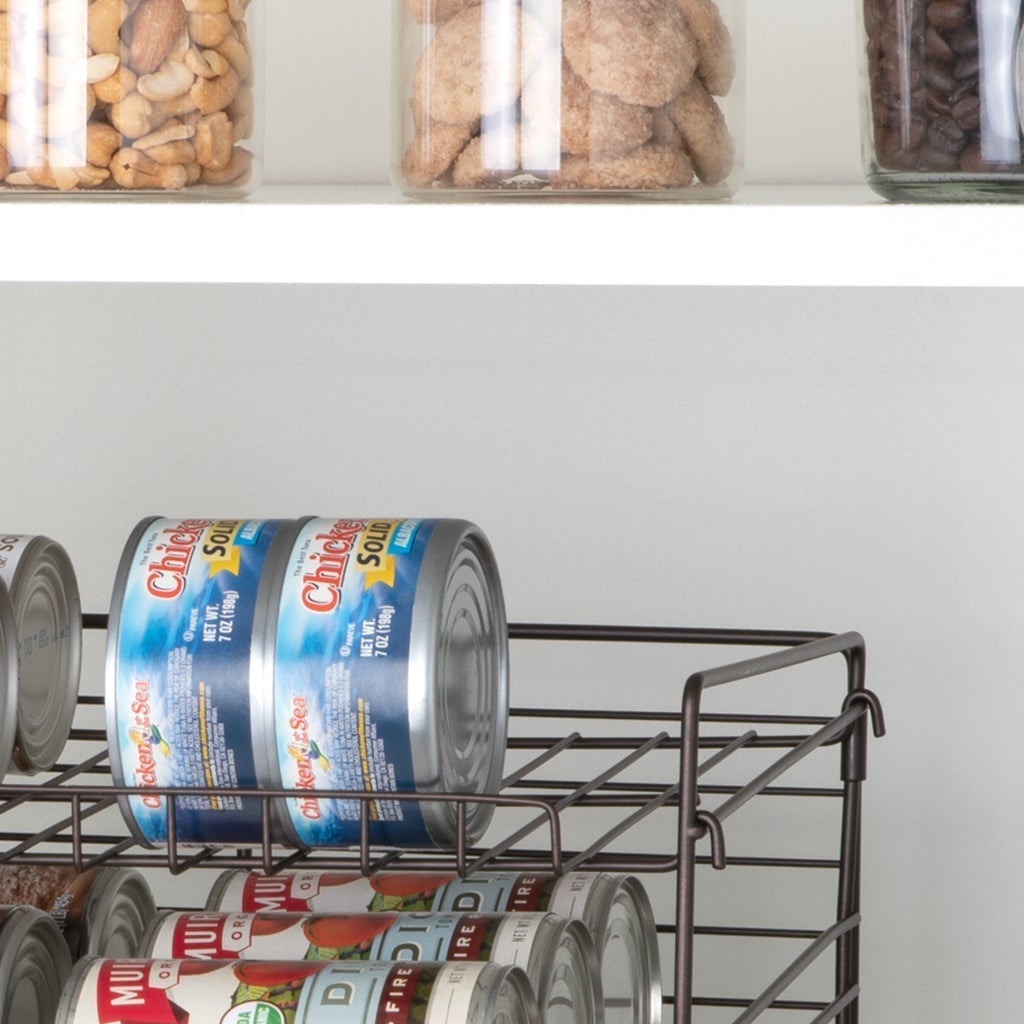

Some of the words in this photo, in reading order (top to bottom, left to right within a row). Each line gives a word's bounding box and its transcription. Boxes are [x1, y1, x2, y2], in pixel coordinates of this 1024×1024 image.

[204, 603, 220, 621] WT.
[219, 590, 240, 618] (198g)
[219, 619, 233, 634] OZ
[361, 618, 376, 637] WT.
[376, 605, 396, 634] (198g)
[203, 621, 216, 642] NET
[360, 637, 373, 657] NET
[375, 634, 389, 650] OZ
[131, 680, 150, 716] Sea
[289, 694, 308, 731] Sea
[512, 929, 527, 943] NET
